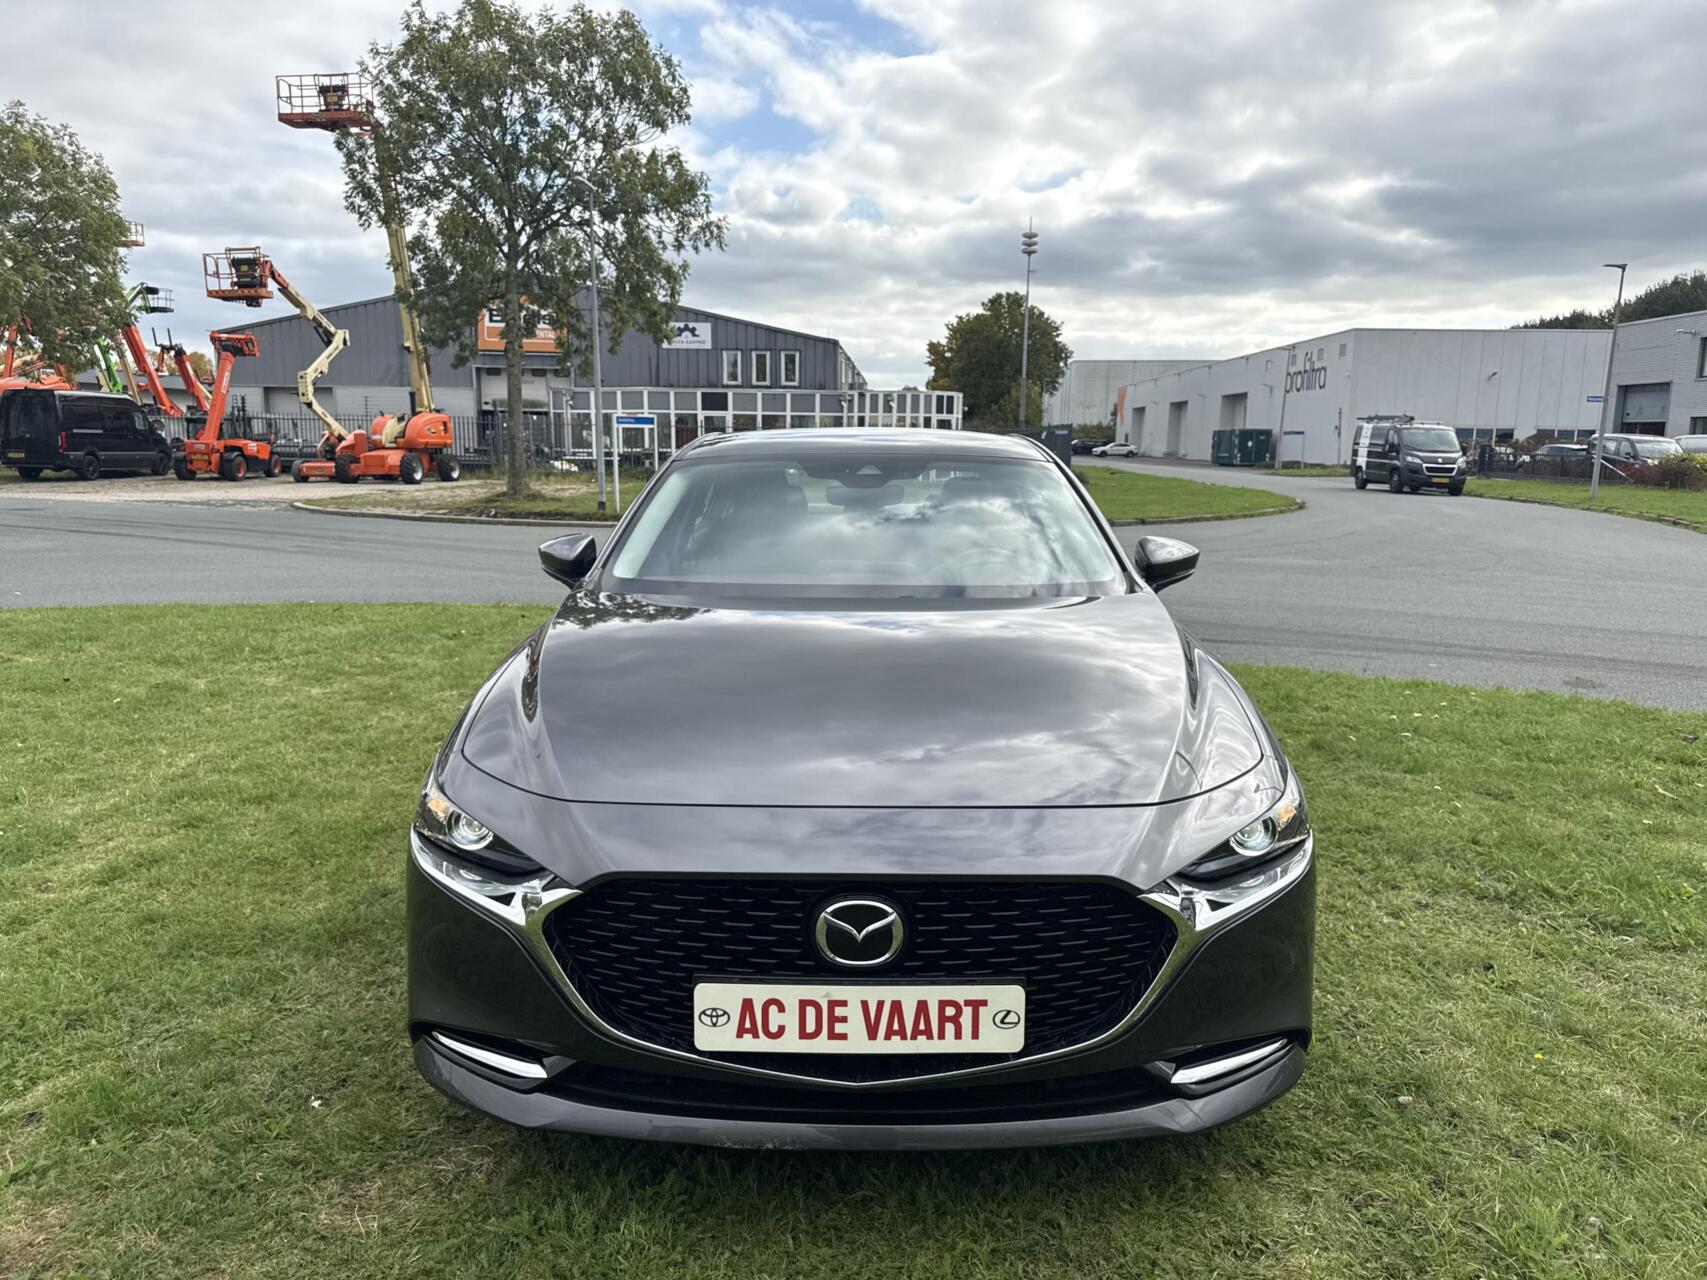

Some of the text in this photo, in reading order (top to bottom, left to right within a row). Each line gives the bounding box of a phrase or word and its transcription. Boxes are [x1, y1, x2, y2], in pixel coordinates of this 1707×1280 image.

[1285, 351, 1327, 394] profiltra
[735, 998, 989, 1041] AC DE VAART
